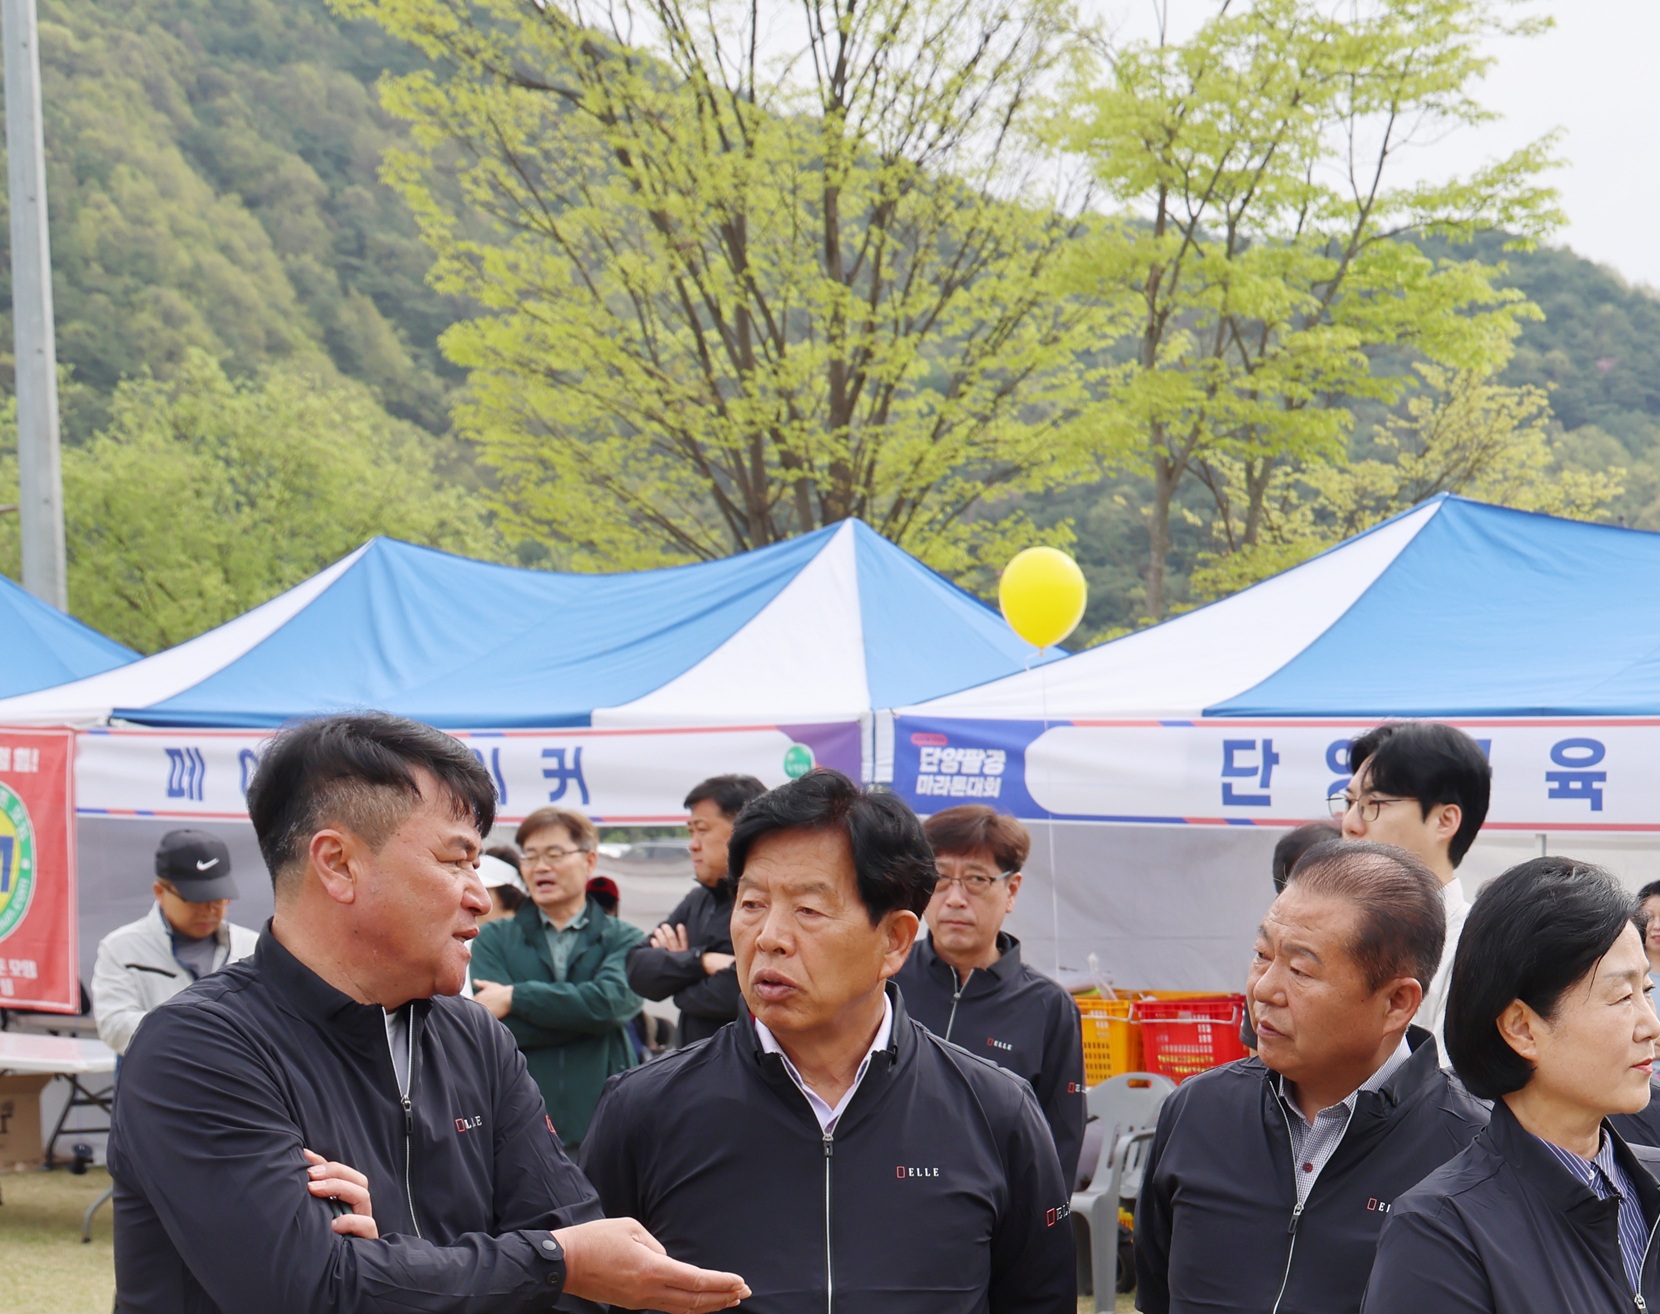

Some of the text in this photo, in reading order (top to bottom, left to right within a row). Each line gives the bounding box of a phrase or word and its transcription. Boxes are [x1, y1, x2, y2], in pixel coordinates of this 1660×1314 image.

[919, 746, 1007, 775] 단양팔경
[915, 774, 1002, 798] 마라톤대회
[908, 1167, 940, 1177] ELLE
